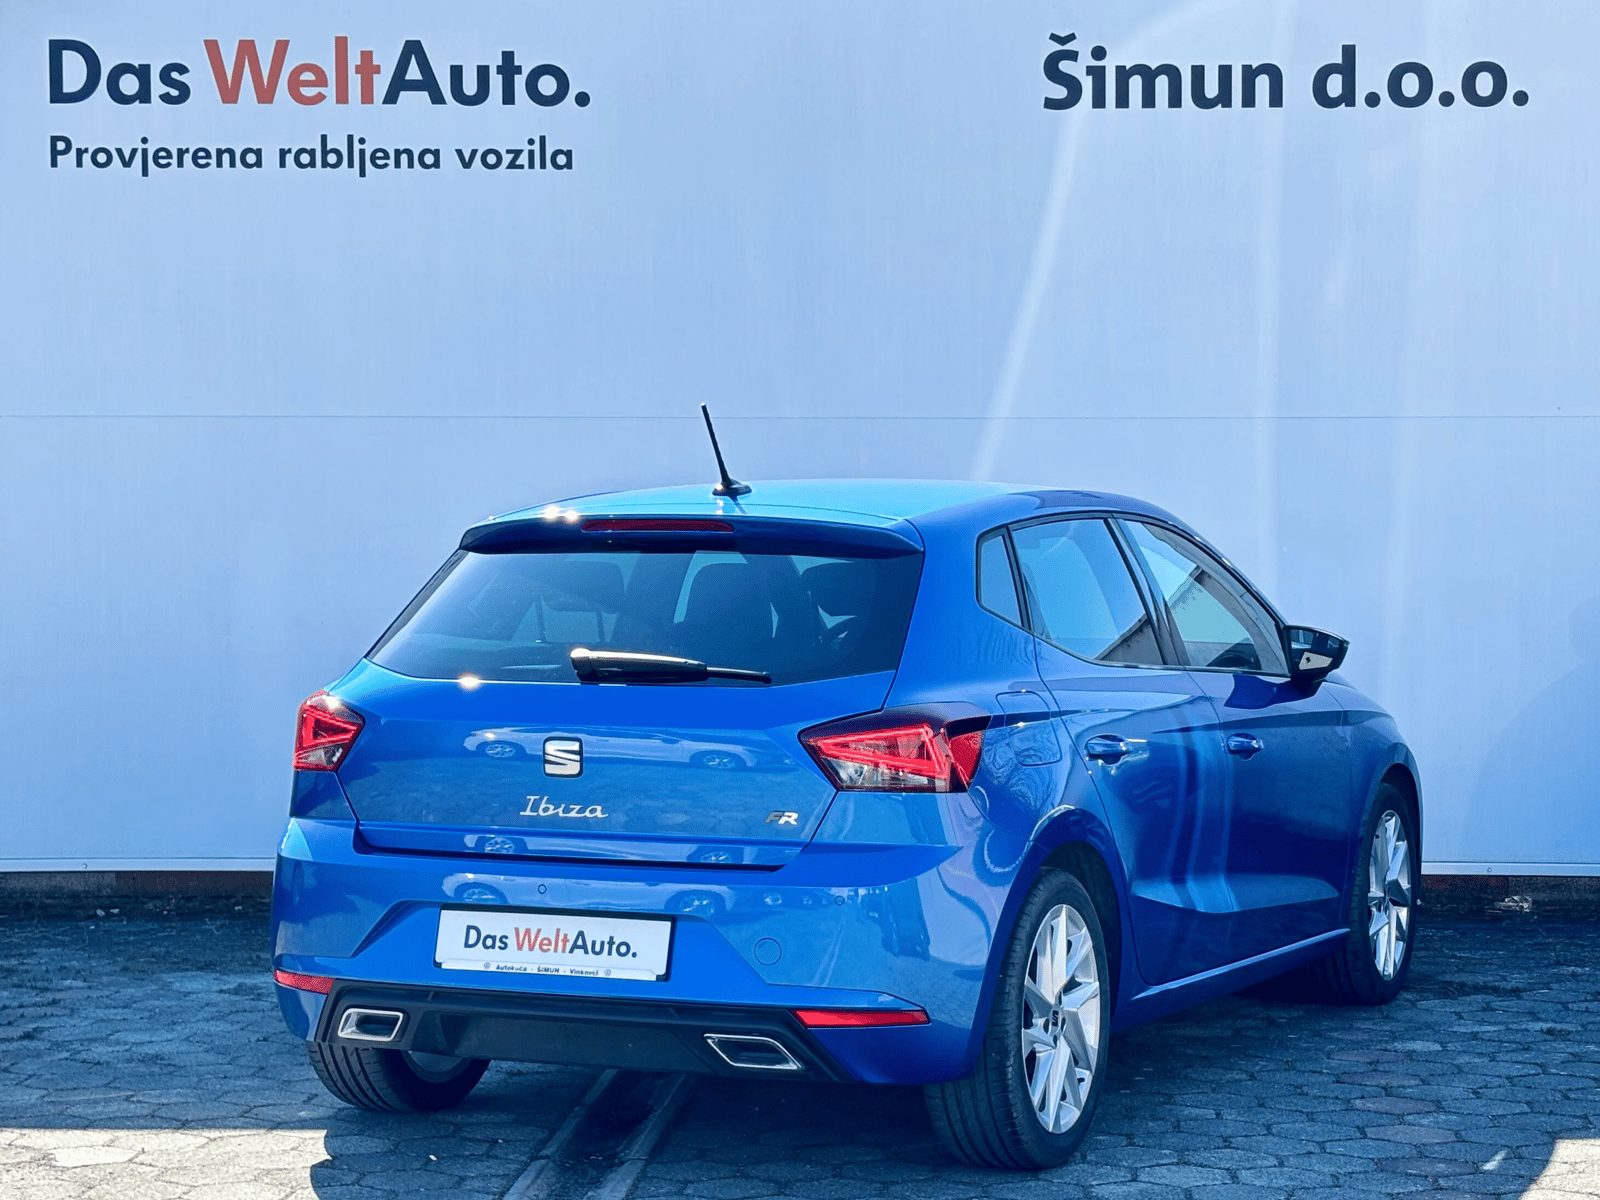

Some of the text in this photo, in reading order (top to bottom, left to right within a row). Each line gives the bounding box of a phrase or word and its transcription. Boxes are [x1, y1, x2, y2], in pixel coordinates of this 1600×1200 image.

[48, 36, 591, 107] Das WeltAuto.
[1043, 32, 1529, 110] Šimun d.o.o.
[49, 134, 574, 178] Provjerena rabljena vozila
[520, 796, 608, 818] Ibiza
[764, 811, 799, 825] FR
[464, 925, 637, 958] Das WeltAuto.
